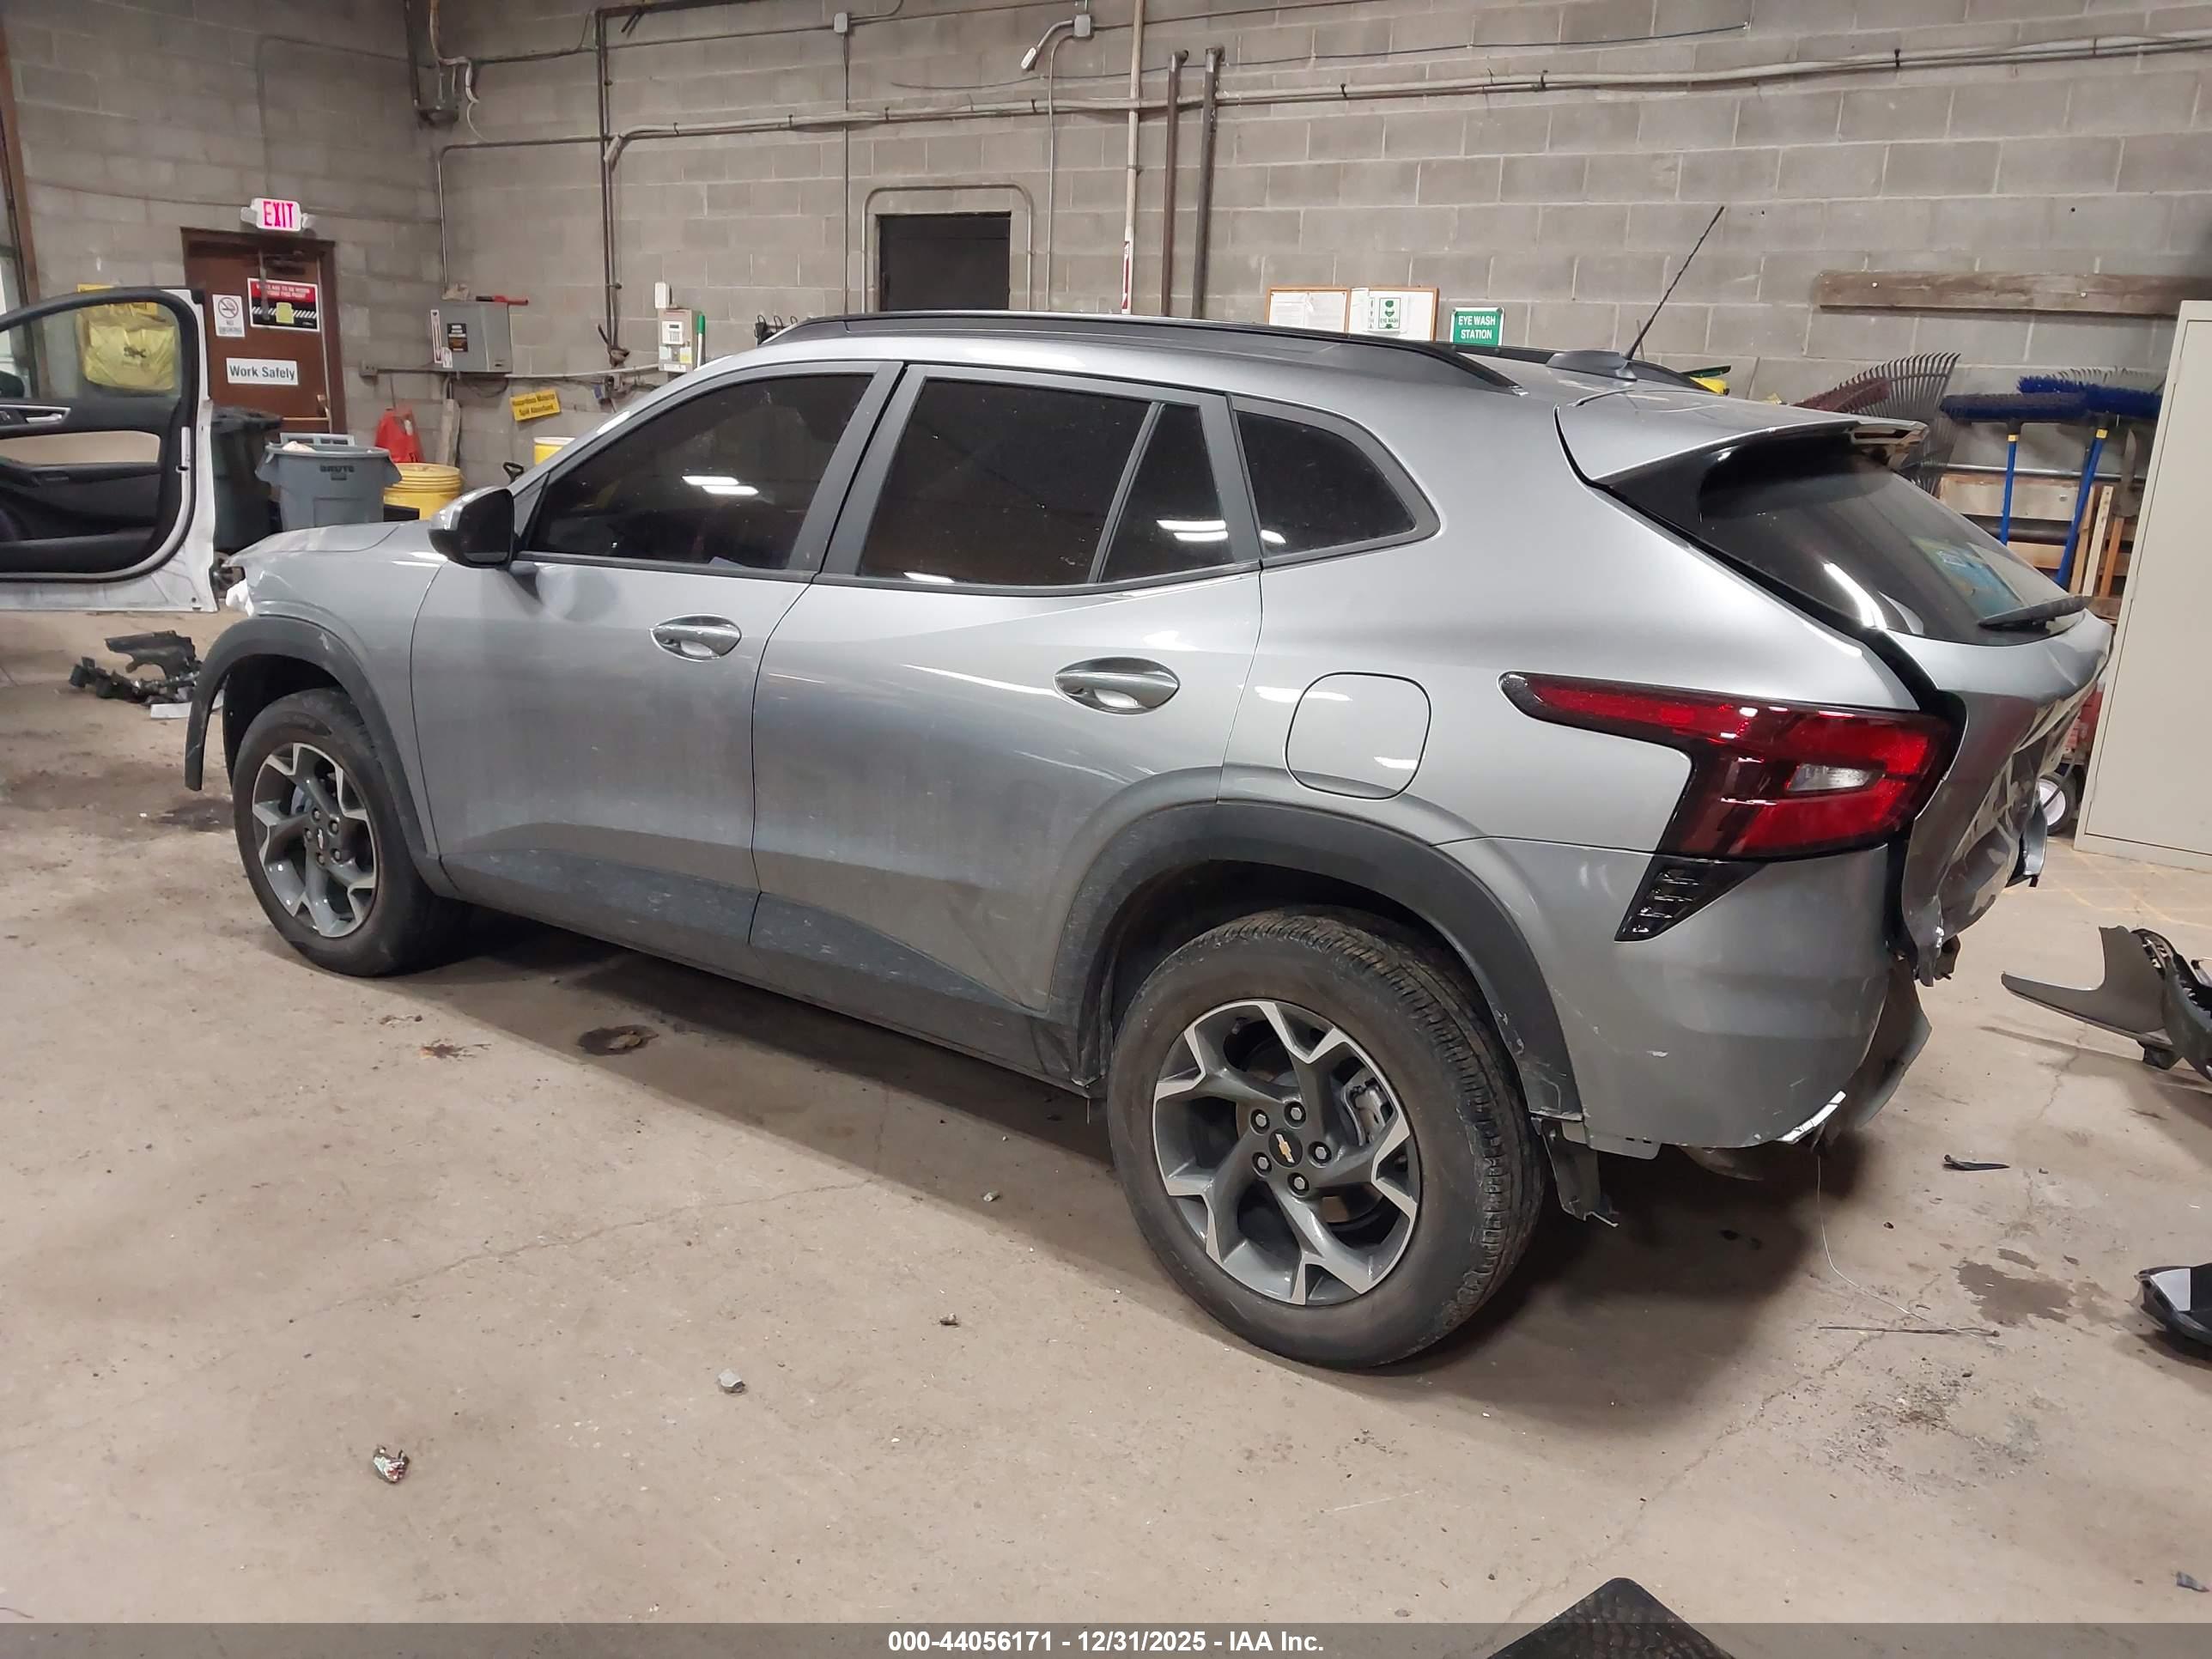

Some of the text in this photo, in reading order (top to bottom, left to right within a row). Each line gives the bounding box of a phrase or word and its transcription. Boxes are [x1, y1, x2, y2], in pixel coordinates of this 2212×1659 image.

[263, 200, 294, 228] EXIT
[1458, 315, 1496, 325] EYE WASH
[1461, 329, 1492, 339] STATION
[229, 365, 295, 380] Work Safely
